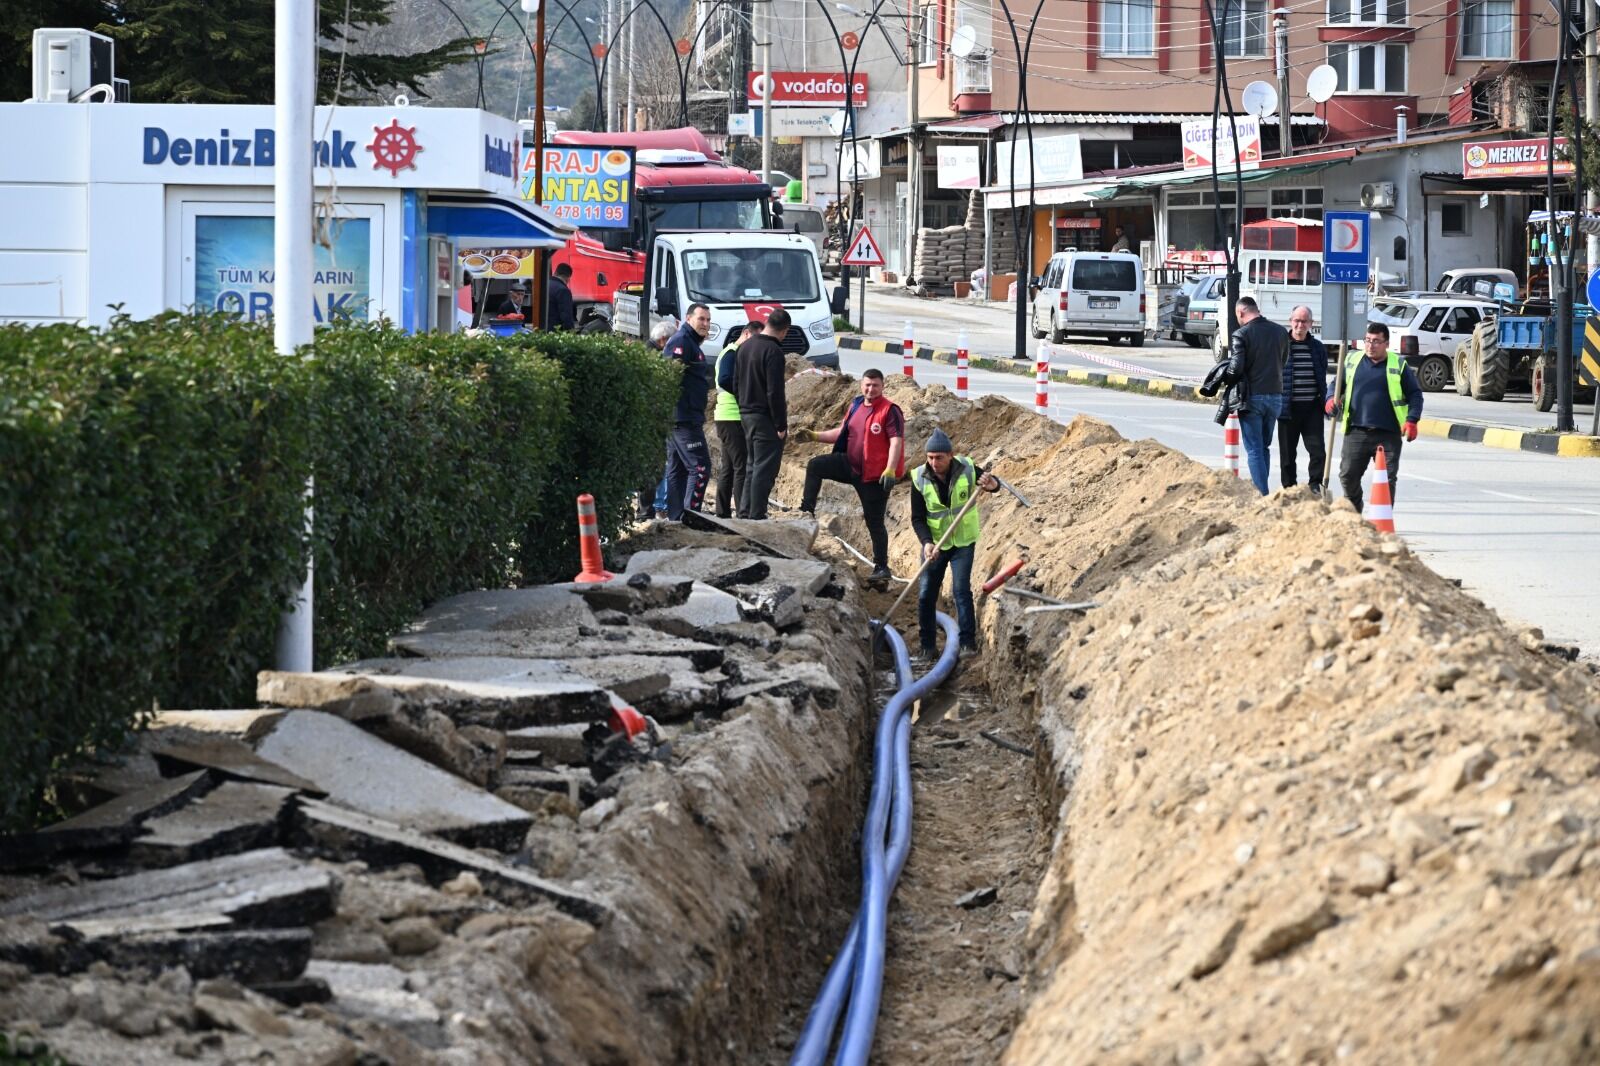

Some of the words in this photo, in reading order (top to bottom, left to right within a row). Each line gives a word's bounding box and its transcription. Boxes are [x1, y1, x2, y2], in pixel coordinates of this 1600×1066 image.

[1226, 122, 1255, 139] ADIN
[143, 127, 357, 168] DenizBnk
[1488, 145, 1538, 164] MERKEZ
[555, 205, 580, 218] 478
[585, 206, 600, 218] 11
[605, 206, 623, 219] 95
[218, 266, 252, 284] TÜM
